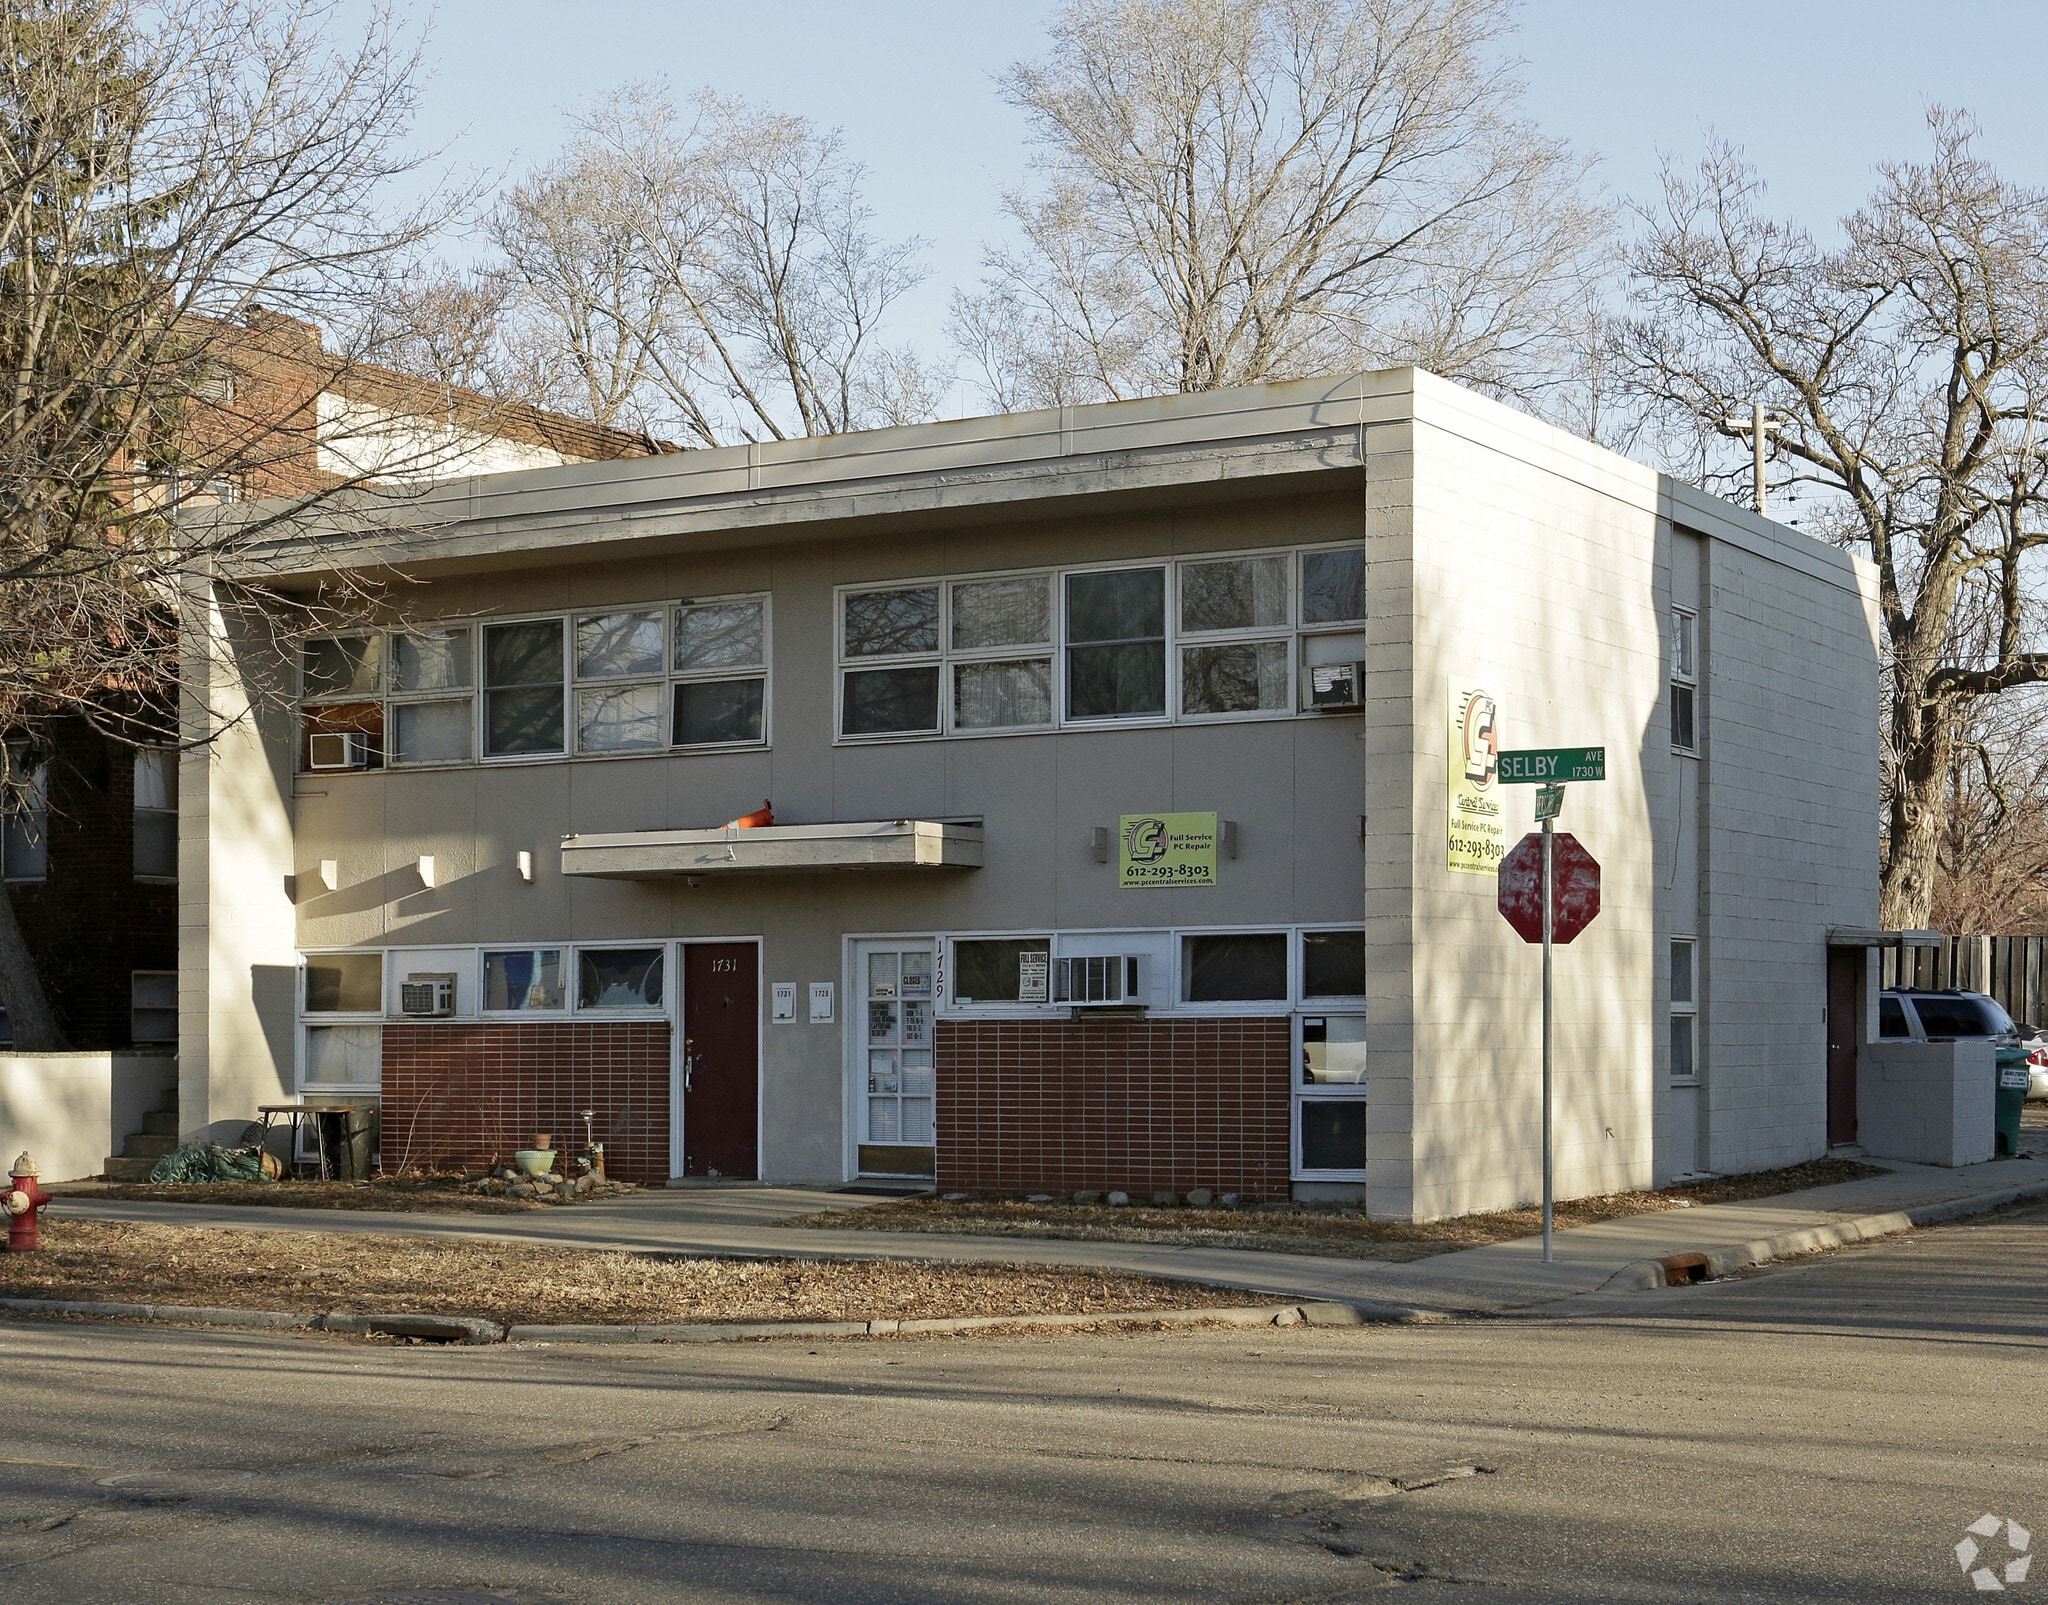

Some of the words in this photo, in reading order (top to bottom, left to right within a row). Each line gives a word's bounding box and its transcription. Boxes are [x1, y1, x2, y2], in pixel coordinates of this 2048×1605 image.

[1585, 751, 1603, 761] AVE
[1501, 756, 1558, 777] SELBY
[1572, 766, 1593, 777] 1730
[1595, 766, 1603, 777] W
[1451, 818, 1460, 829] Full
[1461, 820, 1479, 832] Service
[1480, 823, 1486, 833] PC
[1487, 824, 1503, 837] Repair
[1185, 843, 1211, 851] Repair
[1449, 834, 1505, 861] 612-293-8303
[1126, 864, 1209, 878] 612-293-8303
[1122, 878, 1214, 886] www.pccentralservices.com
[1021, 953, 1030, 964] FULL
[1030, 953, 1047, 964] SERVICE
[712, 958, 737, 973] 1731
[936, 940, 944, 998] 1729
[903, 975, 921, 985] CLOSED
[777, 990, 791, 998] 1731
